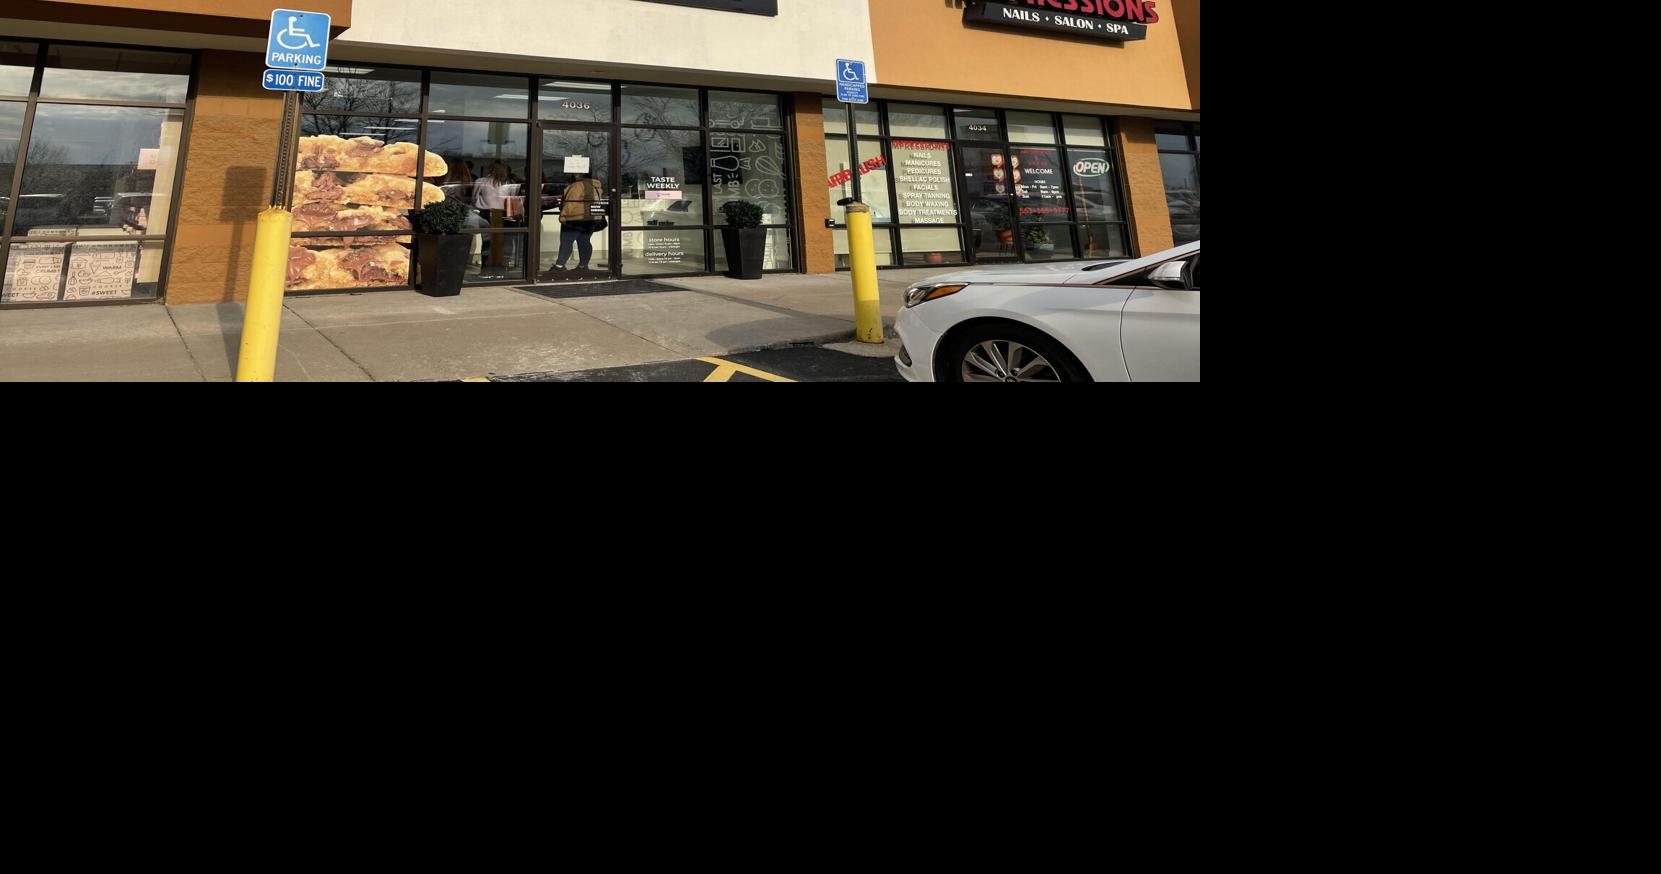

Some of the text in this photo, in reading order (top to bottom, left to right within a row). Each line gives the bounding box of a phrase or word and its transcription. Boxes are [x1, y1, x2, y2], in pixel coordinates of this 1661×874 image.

[1002, 7, 1129, 35] NAILS SALON SPA
[271, 52, 322, 65] PARKING
[265, 73, 322, 87] $100 FINE
[561, 101, 591, 110] 4036
[1075, 161, 1106, 174] OPEN
